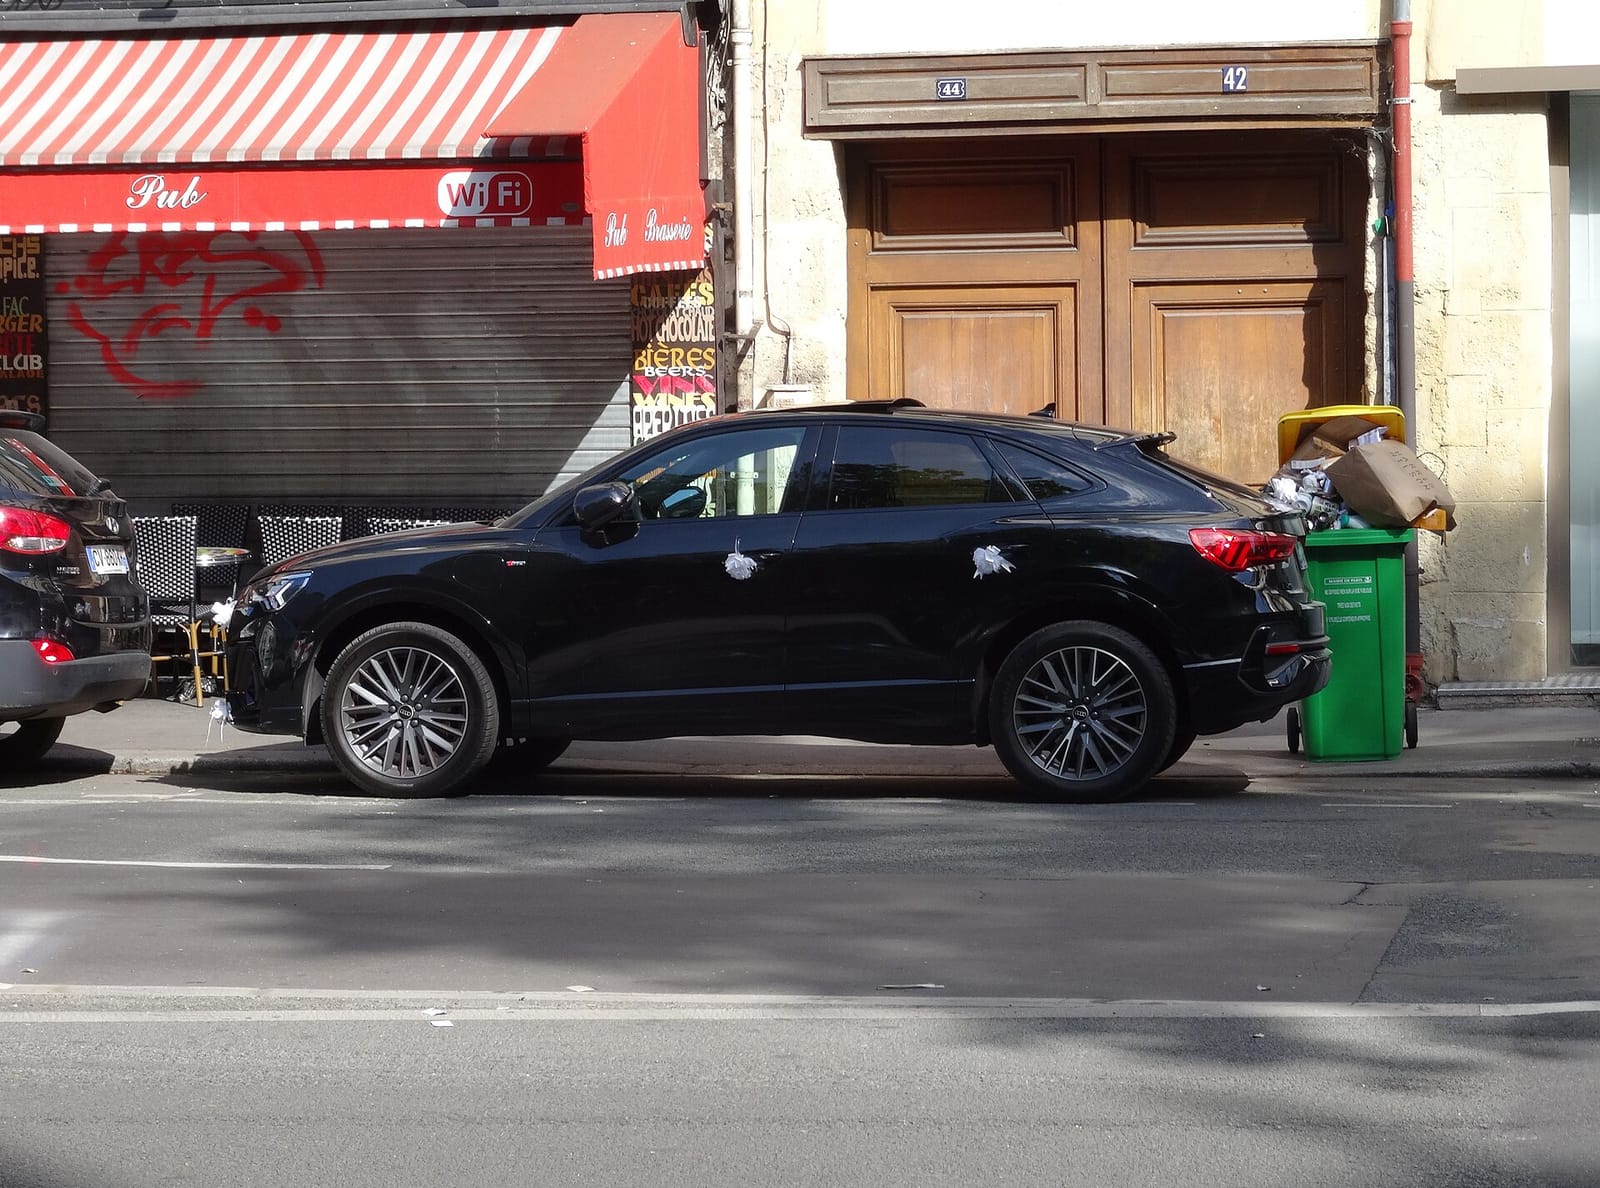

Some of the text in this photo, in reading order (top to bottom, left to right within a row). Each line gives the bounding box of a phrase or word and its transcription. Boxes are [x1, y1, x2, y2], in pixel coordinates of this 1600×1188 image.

[1223, 66, 1247, 90] 42
[942, 83, 960, 96] 44
[126, 174, 207, 209] Pub
[605, 210, 628, 247] Pub
[645, 208, 692, 241] Brasserie
[655, 315, 715, 343] CHOCOLATE
[0, 354, 43, 371] LUB
[644, 365, 706, 377] BEERS
[632, 373, 716, 394] VINS
